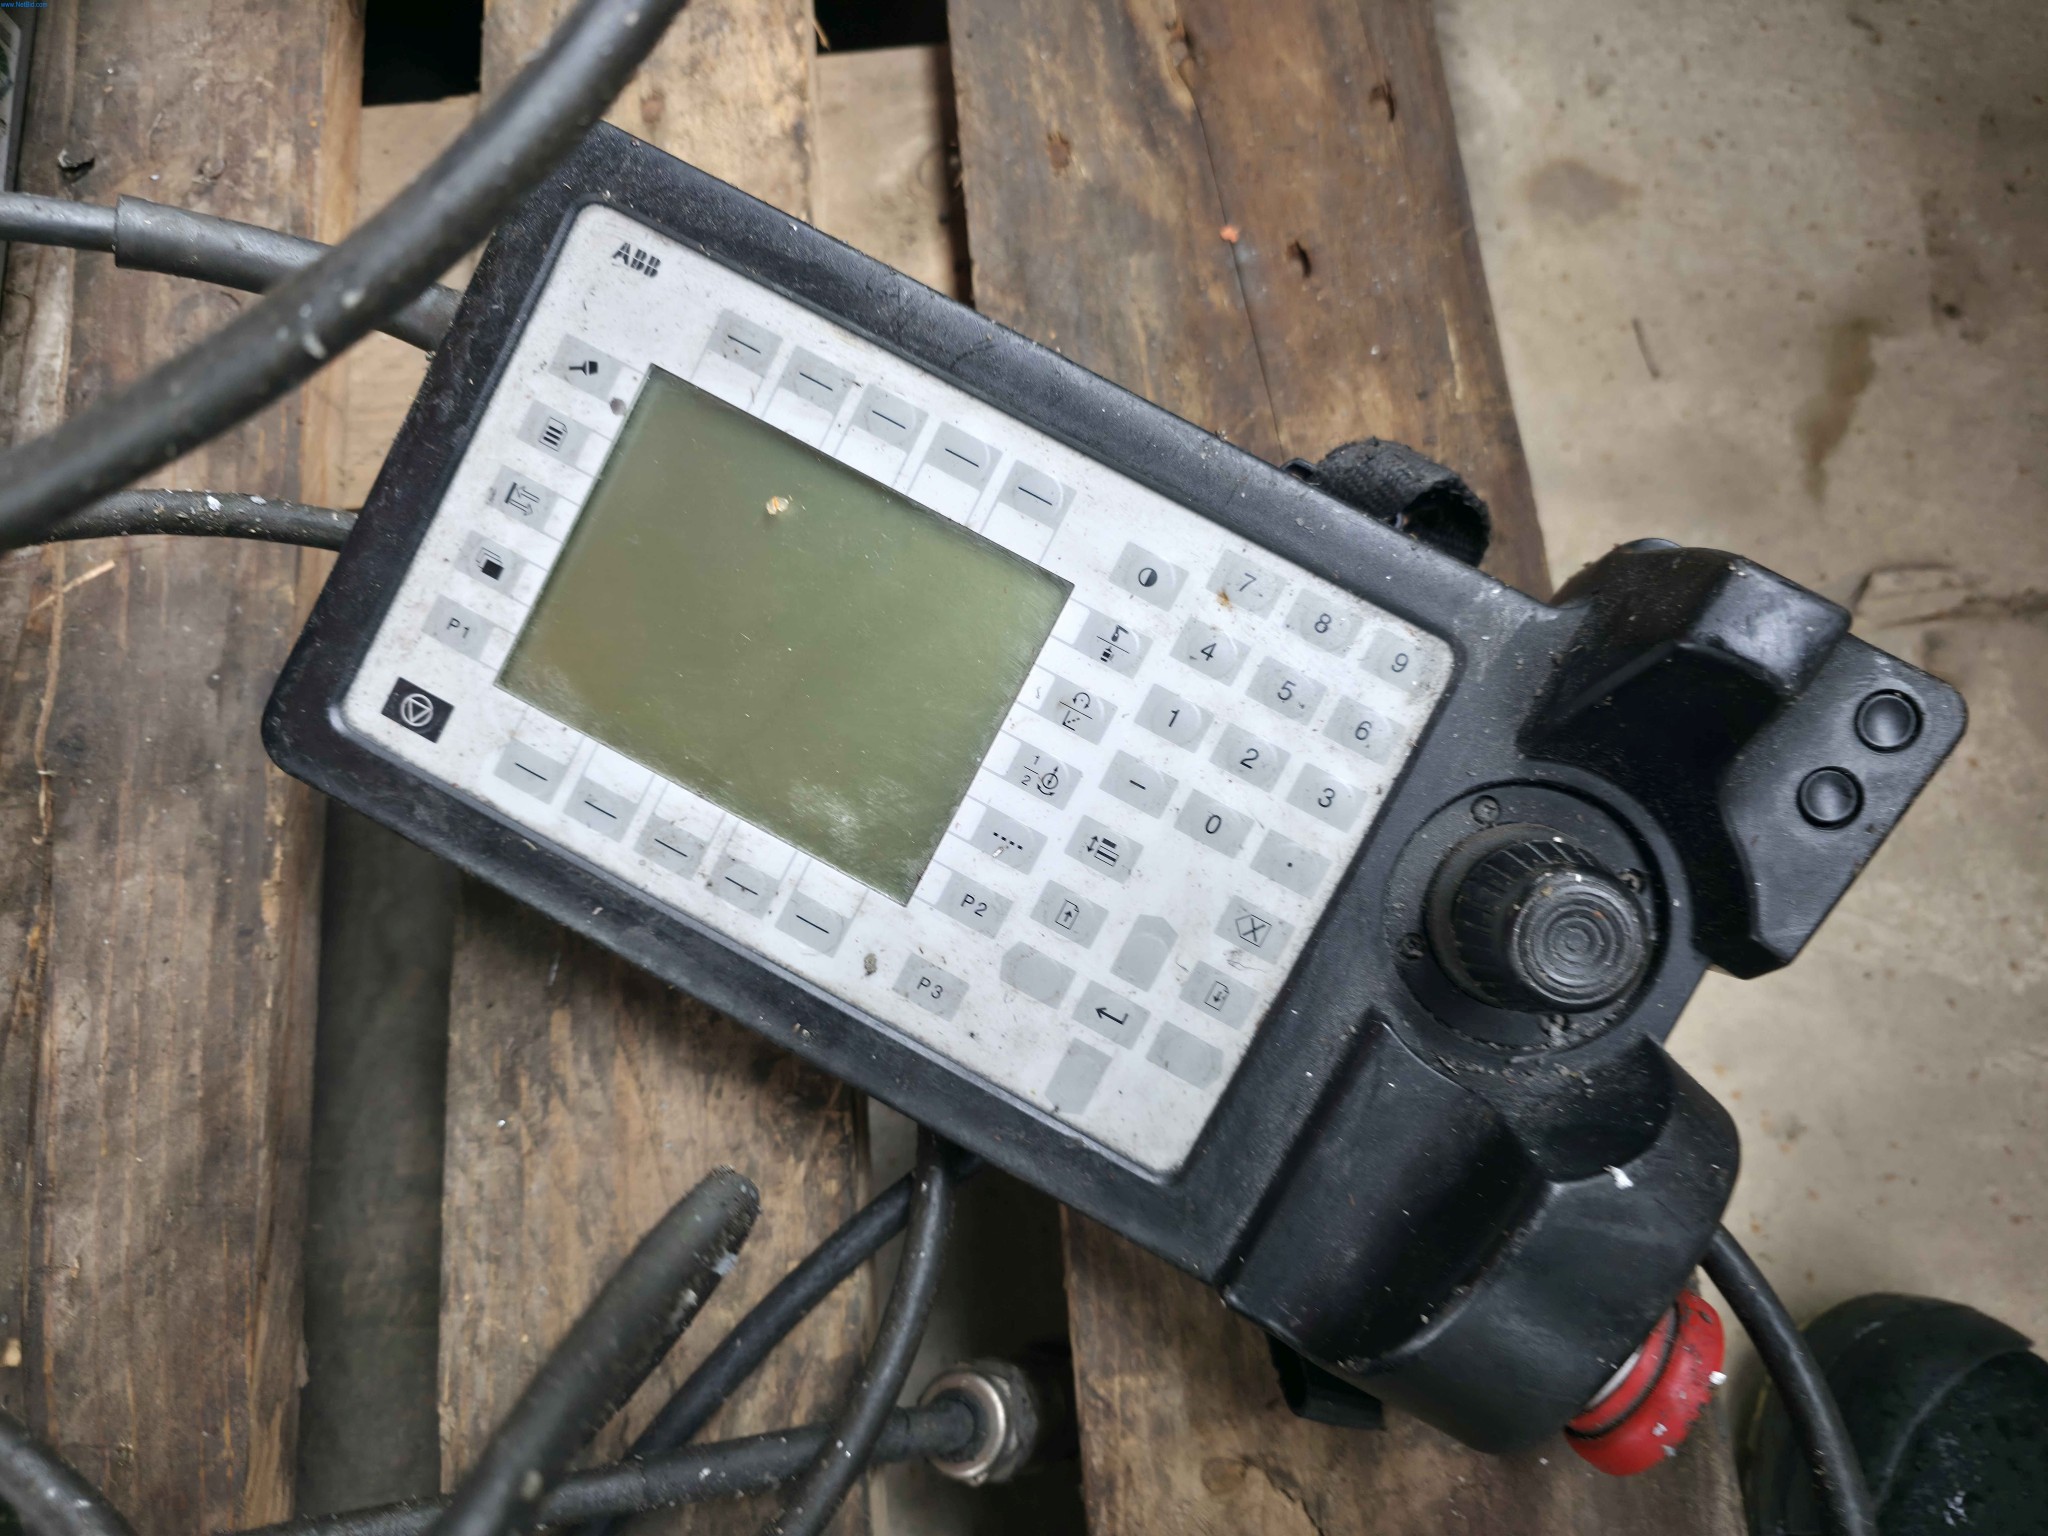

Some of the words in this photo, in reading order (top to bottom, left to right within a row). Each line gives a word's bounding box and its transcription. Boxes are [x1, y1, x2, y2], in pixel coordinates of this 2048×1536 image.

[612, 242, 661, 278] ABB
[446, 617, 471, 639] P1
[1238, 572, 1257, 592] 7
[1314, 612, 1332, 634] 8
[1391, 652, 1409, 673] 9
[1200, 642, 1217, 662] 4
[1277, 680, 1296, 702] 5
[1354, 720, 1372, 741] 6
[1168, 709, 1180, 728] 1
[1239, 748, 1260, 770] 2
[1317, 787, 1335, 808] 3
[960, 893, 988, 918] P2
[916, 976, 944, 1000] P3
